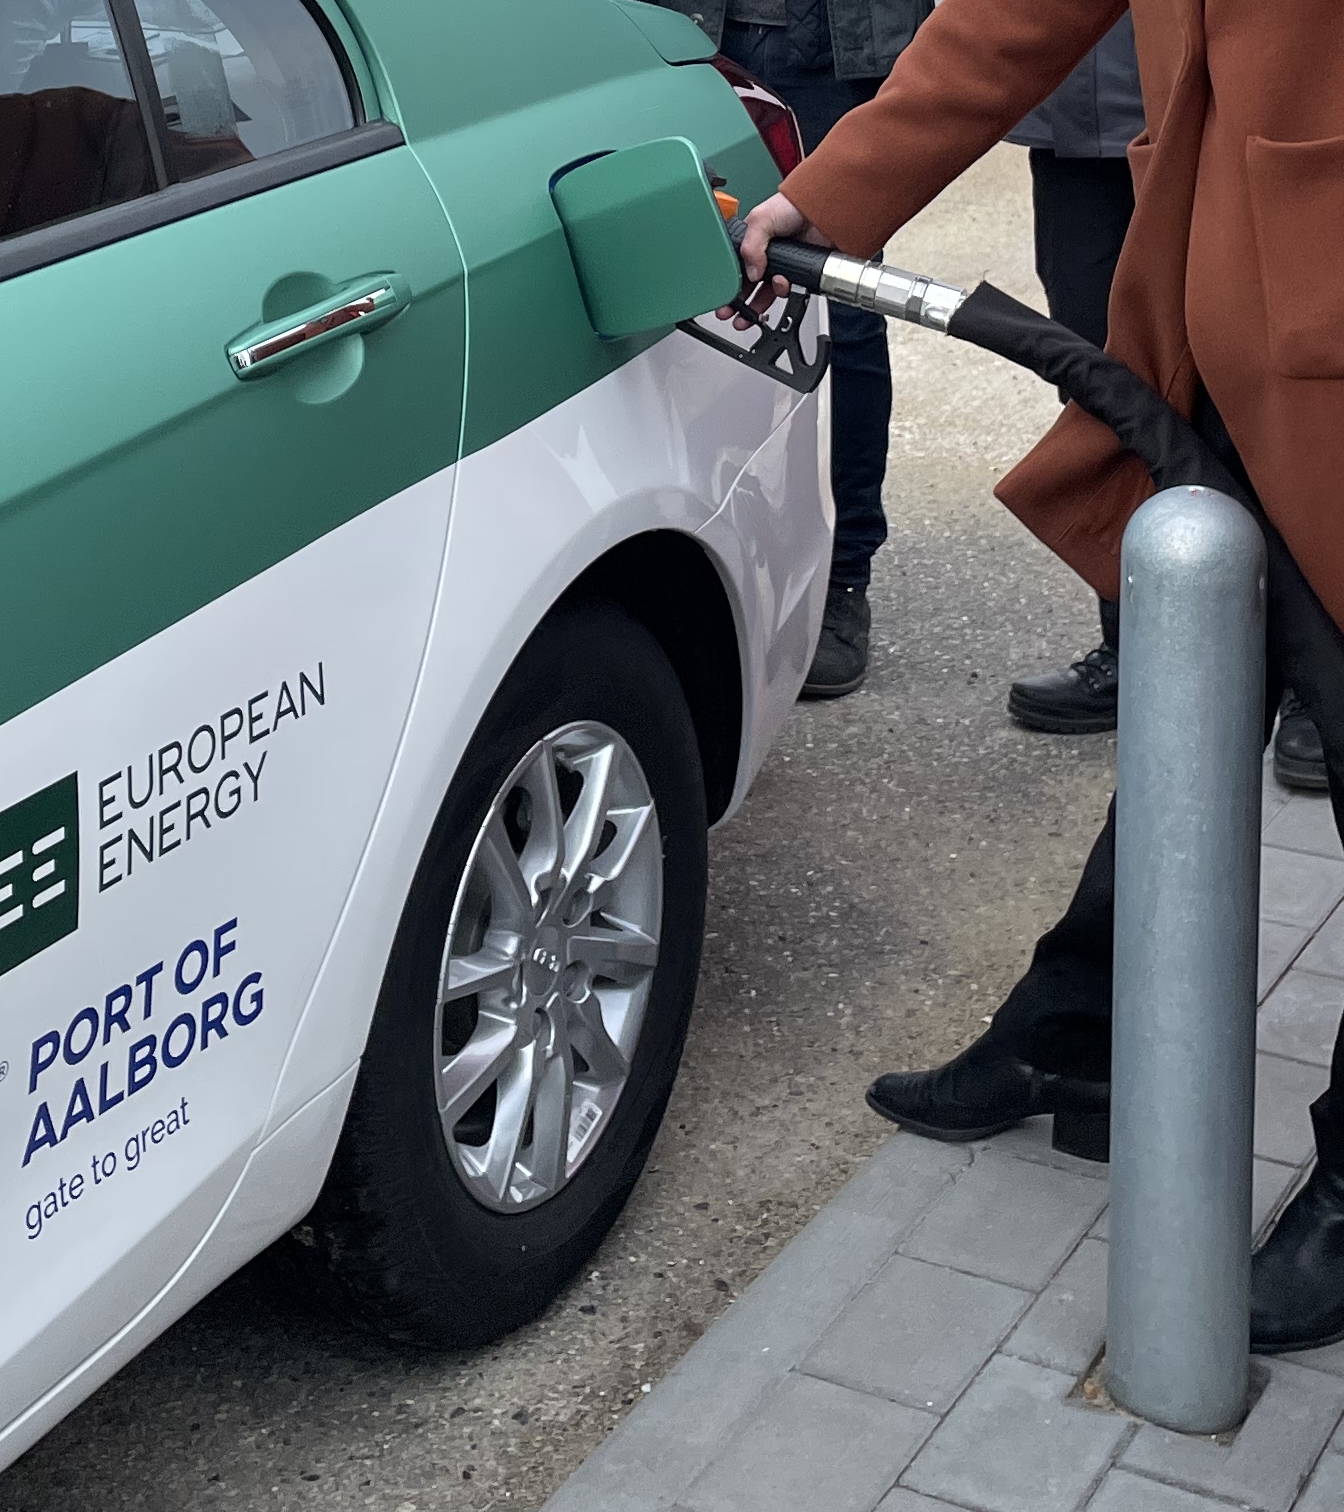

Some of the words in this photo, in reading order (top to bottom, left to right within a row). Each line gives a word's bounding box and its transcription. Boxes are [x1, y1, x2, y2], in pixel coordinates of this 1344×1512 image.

[98, 661, 325, 830] EUROPEAN
[98, 750, 268, 893] ENERGY
[21, 971, 264, 1168] AALBORG
[28, 960, 164, 1095] PORT
[174, 916, 238, 995] OF
[25, 1173, 84, 1240] gate
[91, 1154, 117, 1185] to
[124, 1096, 190, 1172] great
